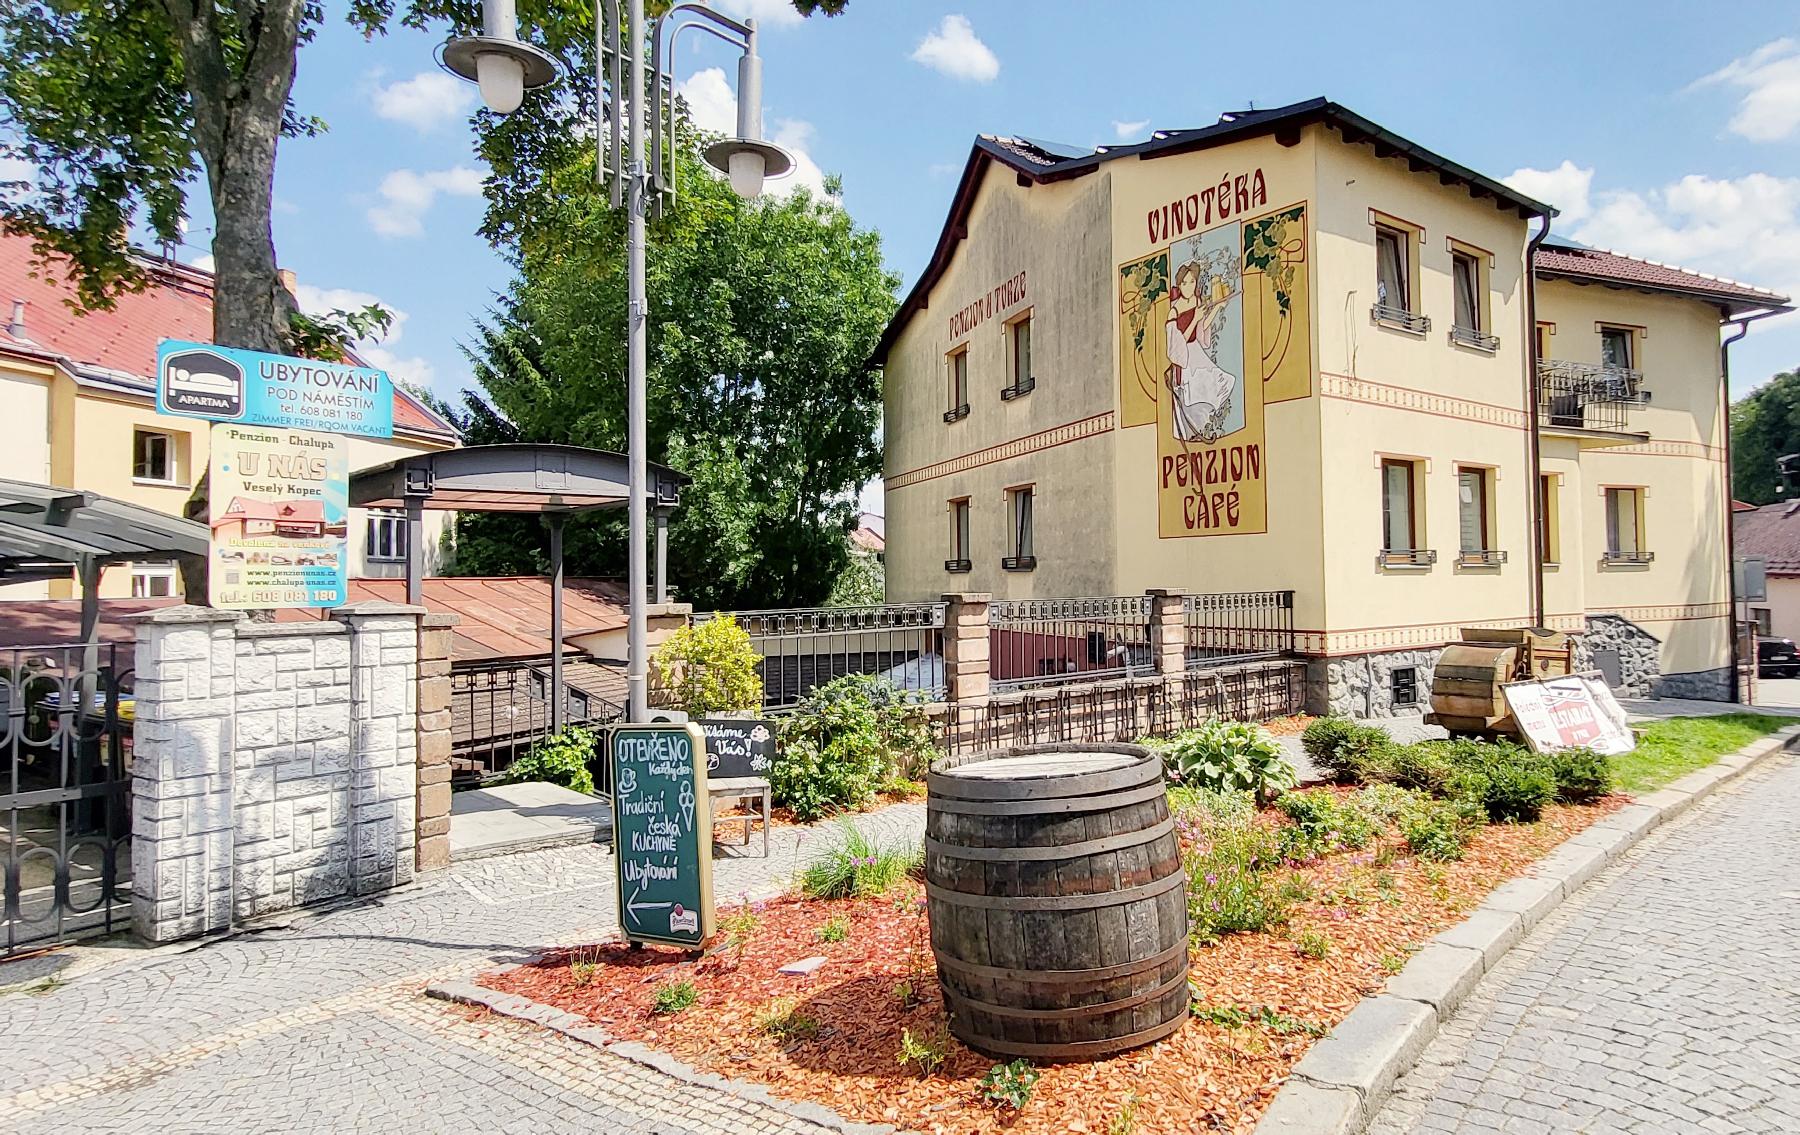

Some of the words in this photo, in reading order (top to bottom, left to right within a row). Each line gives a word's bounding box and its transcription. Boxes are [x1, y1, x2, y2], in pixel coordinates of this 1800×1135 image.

[1147, 168, 1267, 244] VINOTÉKA
[949, 298, 984, 341] PENZION
[986, 292, 992, 319] U
[260, 361, 379, 393] UBYTOVÁNÍ
[267, 386, 298, 400] POD
[252, 413, 292, 425] ZIMMER
[351, 425, 387, 434] VACANT
[281, 404, 297, 414] tel.
[300, 406, 320, 416] 608
[322, 408, 341, 418] 081
[345, 410, 363, 421] 180
[230, 429, 279, 444] Penzion
[289, 434, 335, 451] Chalupa
[237, 451, 261, 477] U
[267, 450, 329, 482] NÁS
[1161, 444, 1260, 489] PENZION
[242, 481, 284, 496] Veselý
[287, 484, 323, 497] Kopec
[1183, 485, 1240, 530] CAFÉ
[251, 591, 279, 604] 608
[284, 591, 309, 604] 081
[313, 590, 337, 601] 180
[618, 732, 689, 763] OTEVŘENO
[714, 738, 752, 758] Vás!
[618, 790, 665, 816] Tradiční
[624, 855, 678, 891] Ubytování
